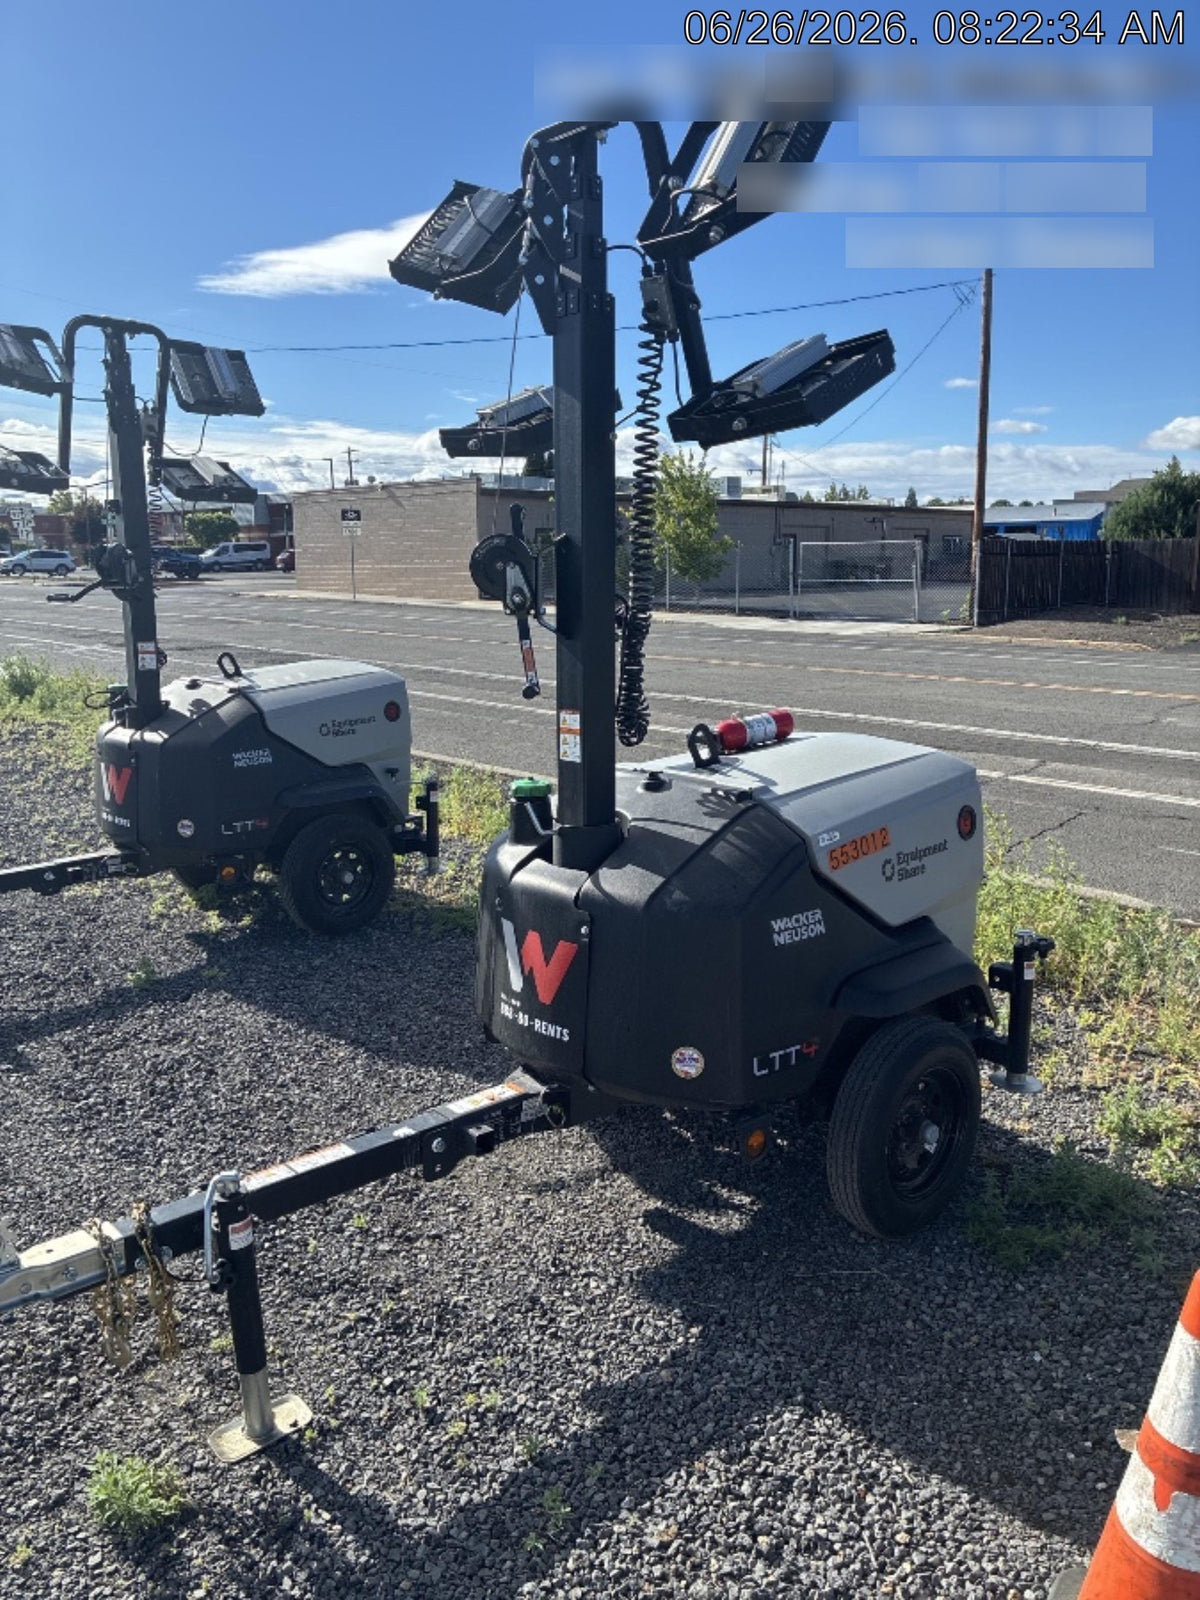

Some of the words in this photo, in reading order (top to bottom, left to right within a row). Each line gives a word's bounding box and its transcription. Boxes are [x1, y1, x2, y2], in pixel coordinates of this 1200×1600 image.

[829, 827, 890, 870] 553012
[896, 838, 949, 866] Equipment
[897, 863, 927, 882] Share
[770, 908, 823, 932] WACKER
[773, 920, 826, 947] NEUSON
[753, 1037, 819, 1077] LTT4
